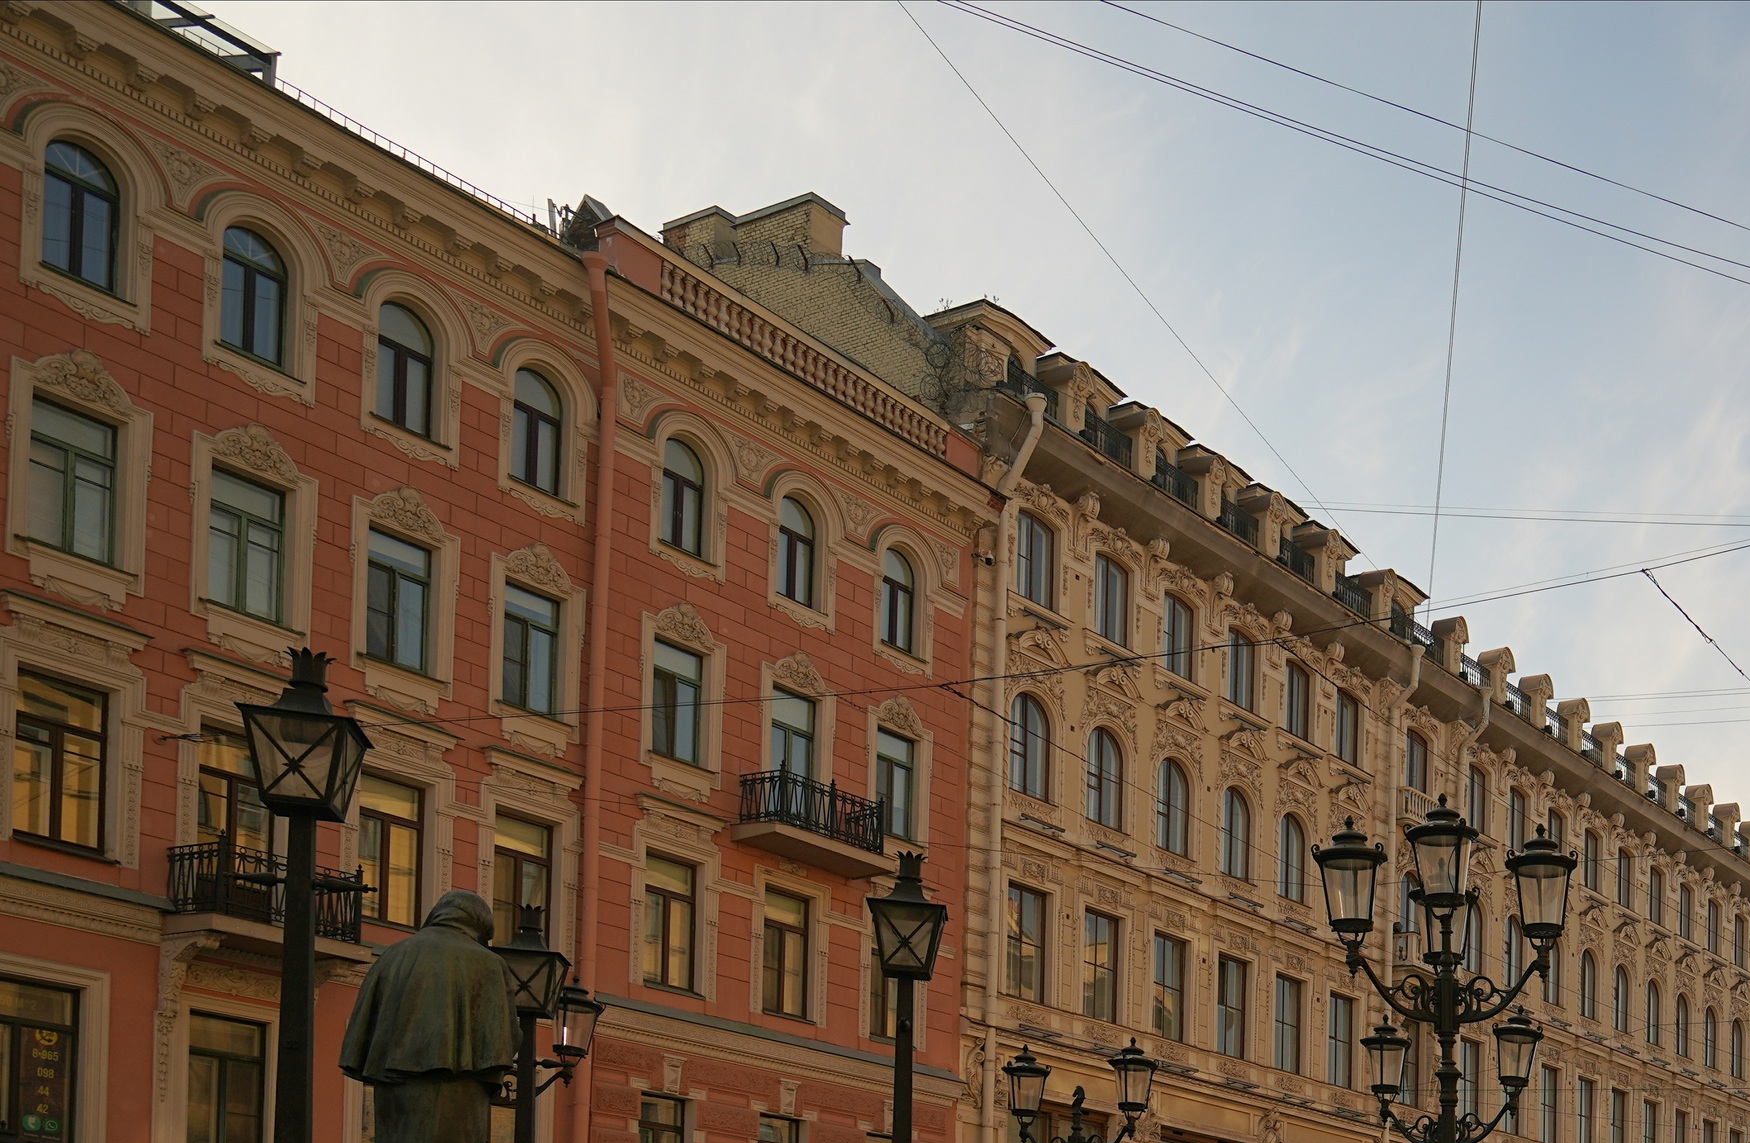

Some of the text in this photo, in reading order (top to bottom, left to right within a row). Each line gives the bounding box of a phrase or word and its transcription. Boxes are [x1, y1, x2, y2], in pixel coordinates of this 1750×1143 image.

[32, 1048, 59, 1062] 8-965
[37, 1067, 55, 1079] 098
[37, 1086, 50, 1097] 44
[36, 1104, 49, 1114] 42
